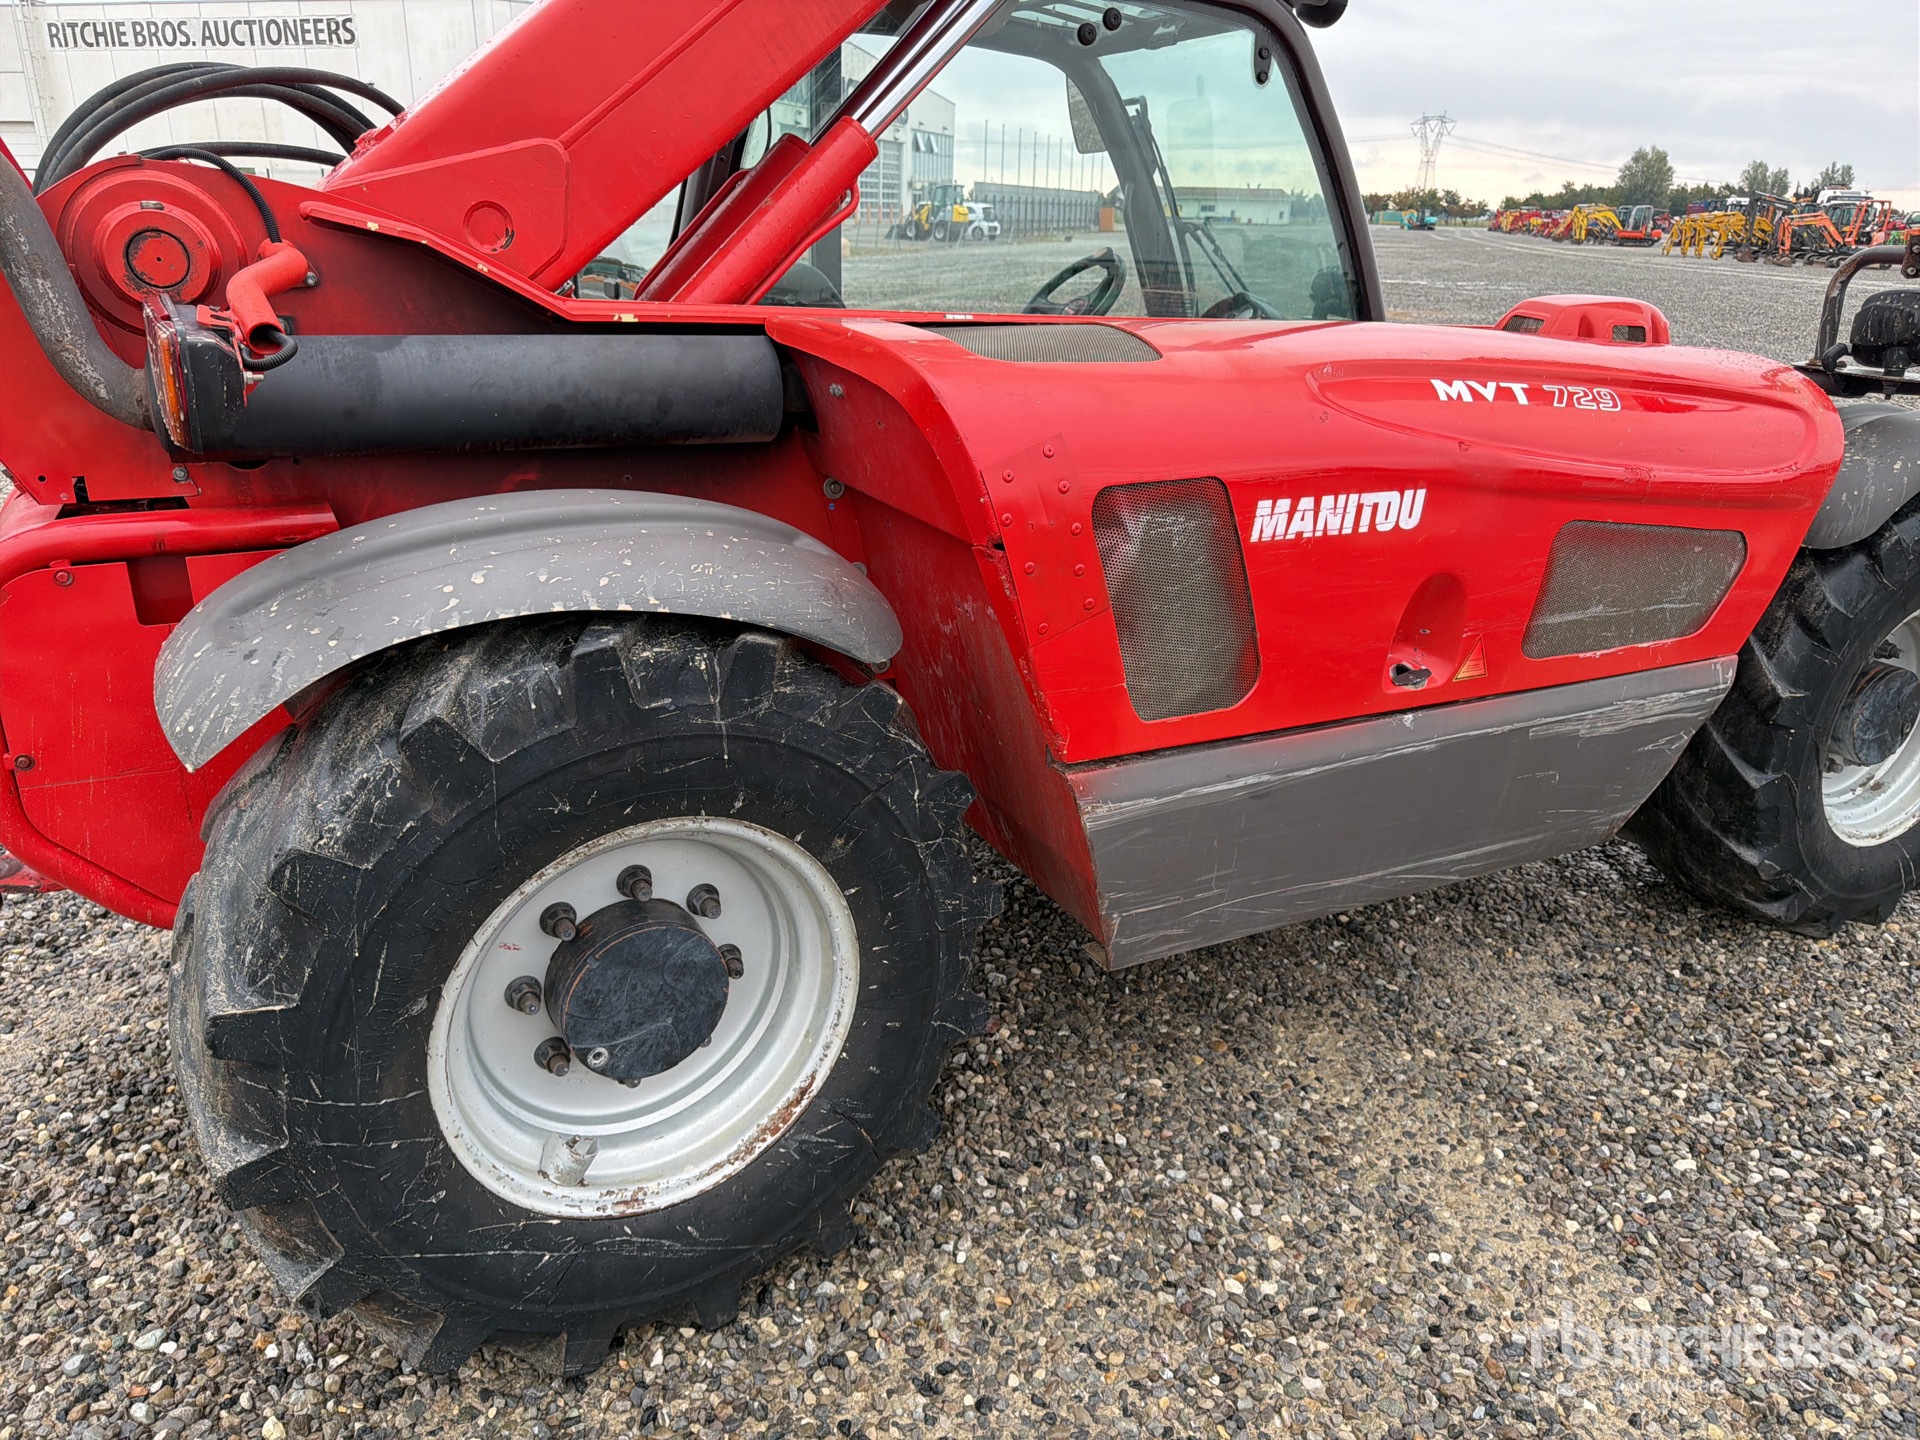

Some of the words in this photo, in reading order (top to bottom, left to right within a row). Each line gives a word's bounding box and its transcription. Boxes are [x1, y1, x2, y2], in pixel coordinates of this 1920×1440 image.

[47, 21, 129, 48] RITCHIE
[131, 20, 196, 47] BROS.
[201, 17, 356, 47] AUCTIONEERS
[1429, 378, 1530, 406] MVT
[1541, 384, 1622, 412] 729
[1249, 488, 1427, 543] MANITOU
